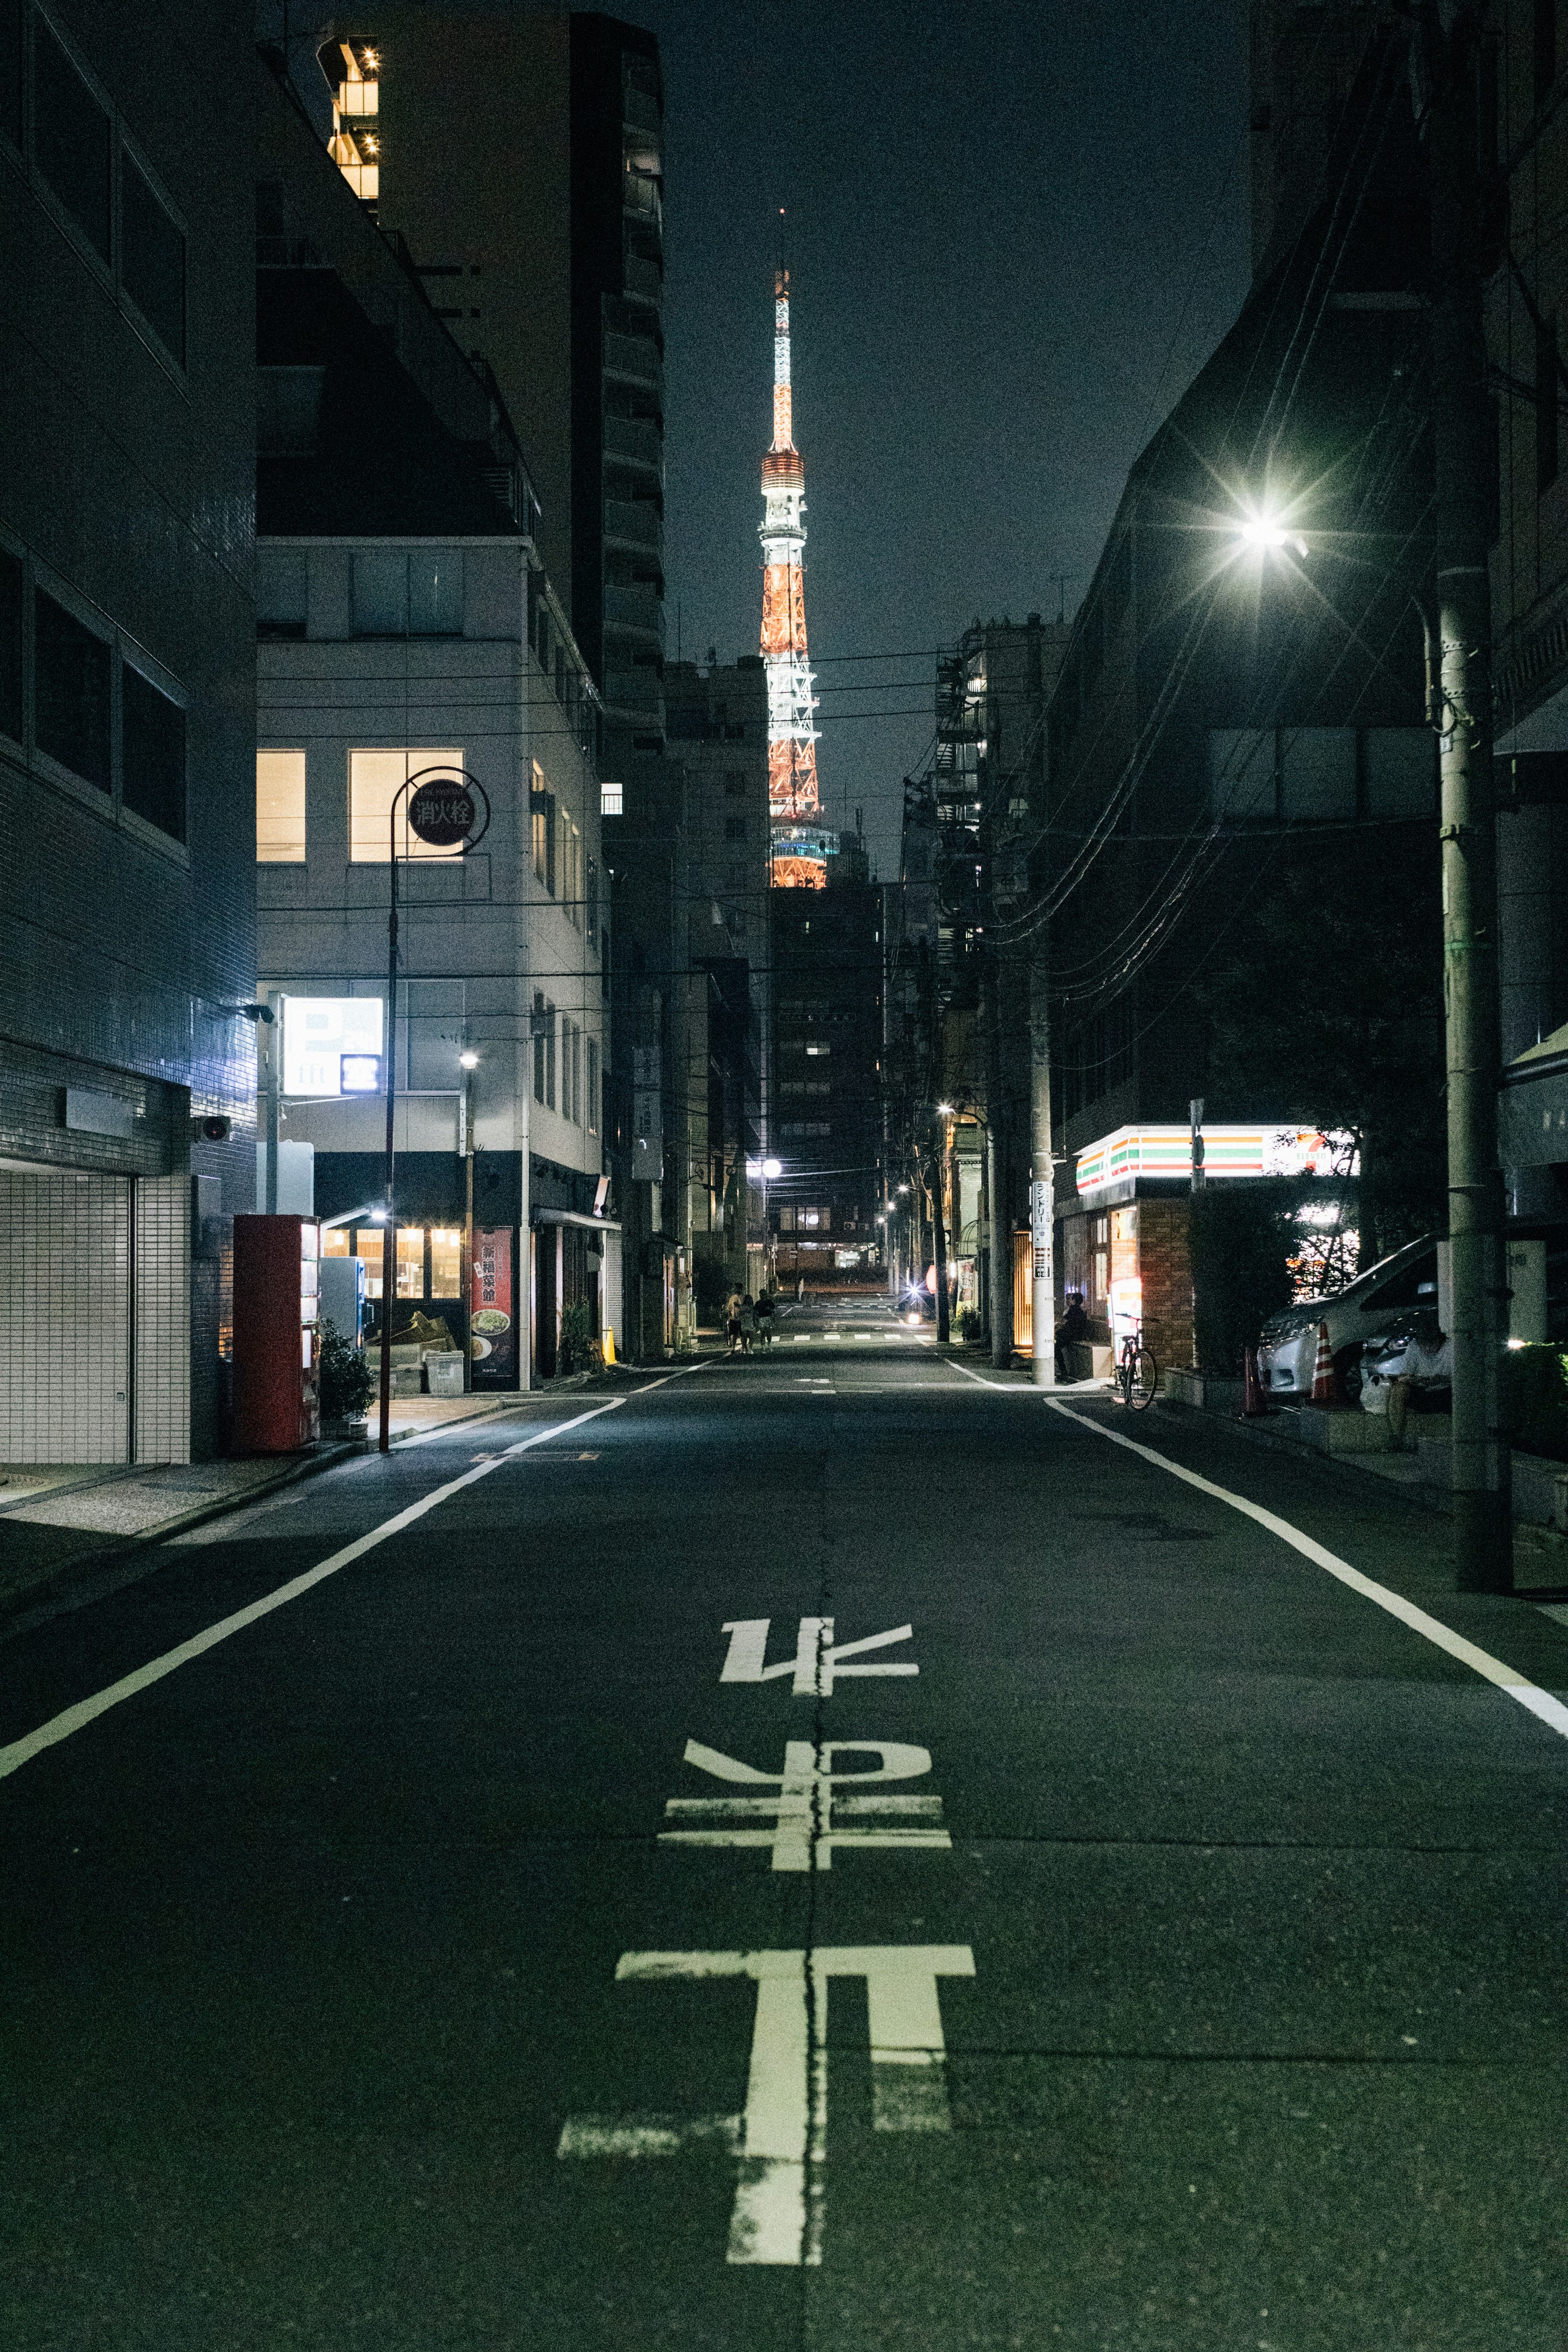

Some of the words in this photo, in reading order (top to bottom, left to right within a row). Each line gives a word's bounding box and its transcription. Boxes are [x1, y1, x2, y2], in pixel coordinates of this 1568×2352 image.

[416, 799, 470, 826] 消火栓
[292, 1002, 344, 1052] P
[1037, 1183, 1046, 1223] ランドリー
[481, 1245, 496, 1302] 新福菜館
